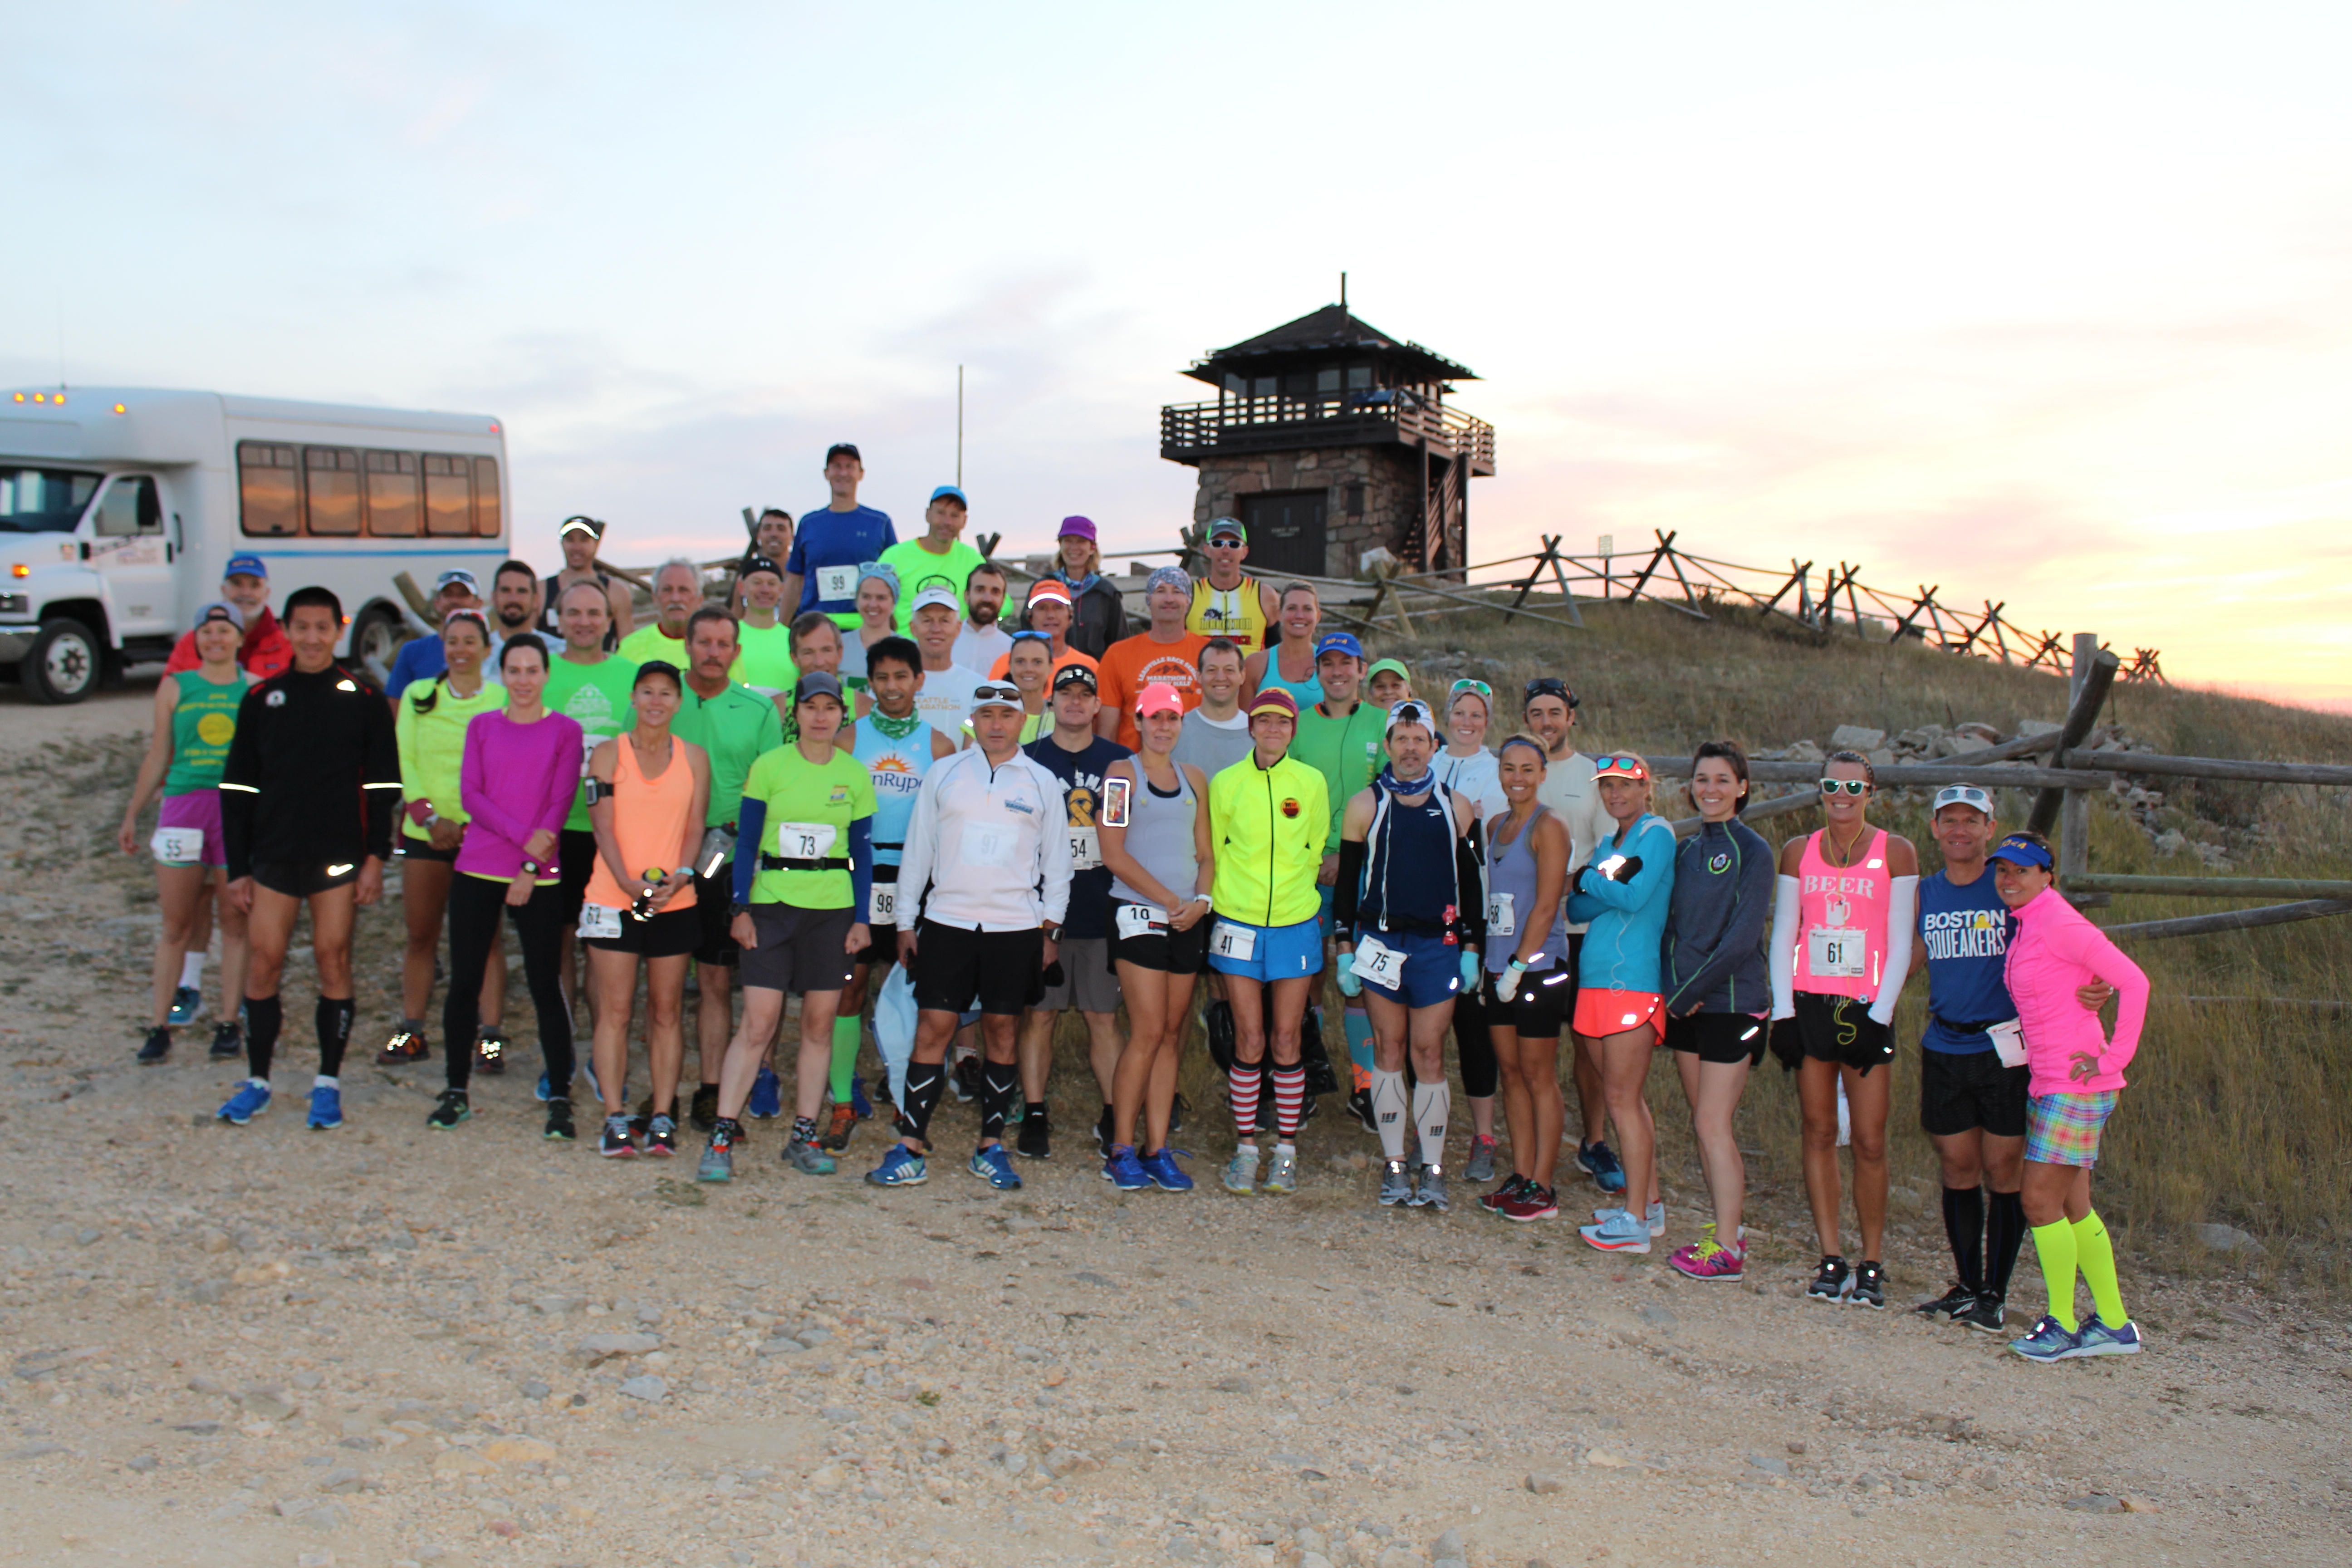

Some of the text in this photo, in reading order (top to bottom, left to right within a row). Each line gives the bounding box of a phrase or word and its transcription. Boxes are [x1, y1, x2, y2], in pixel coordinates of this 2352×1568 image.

[832, 575, 844, 591] 99
[1137, 657, 1166, 681] LEADVILLE
[1166, 656, 1185, 665] RACE
[165, 838, 181, 857] 55
[800, 835, 815, 855] 73
[981, 834, 998, 851] 97
[1071, 839, 1086, 858] 54
[1804, 875, 1874, 900] BEER
[877, 892, 893, 913] 98
[1131, 907, 1150, 920] 10
[1925, 909, 2006, 931] BOSTON
[1220, 935, 1232, 954] 41
[1828, 942, 1843, 963] 61
[1924, 926, 2006, 960] SQUEAKERS
[1371, 951, 1390, 971] 75
